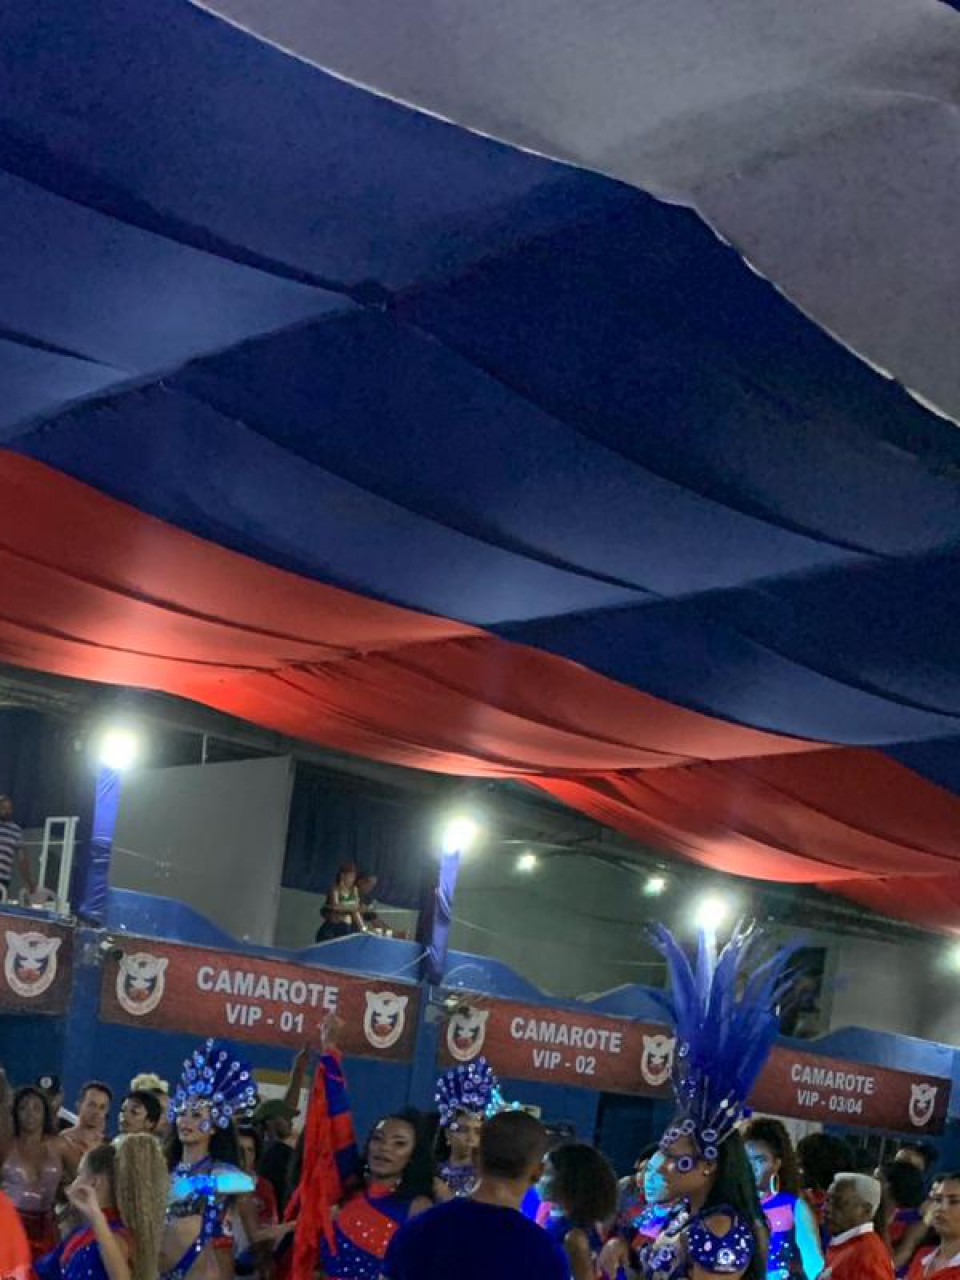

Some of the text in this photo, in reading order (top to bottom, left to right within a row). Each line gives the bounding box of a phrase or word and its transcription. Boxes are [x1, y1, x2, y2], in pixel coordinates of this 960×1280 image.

[196, 965, 339, 1010] CAMAROTE
[225, 1002, 263, 1026] VIP
[279, 1011, 305, 1033] 01
[510, 1016, 622, 1053] CAMAROTE
[532, 1049, 561, 1070] VIP
[575, 1055, 597, 1075] 02
[791, 1063, 875, 1095] CAMAROTE
[796, 1089, 820, 1107] VIP
